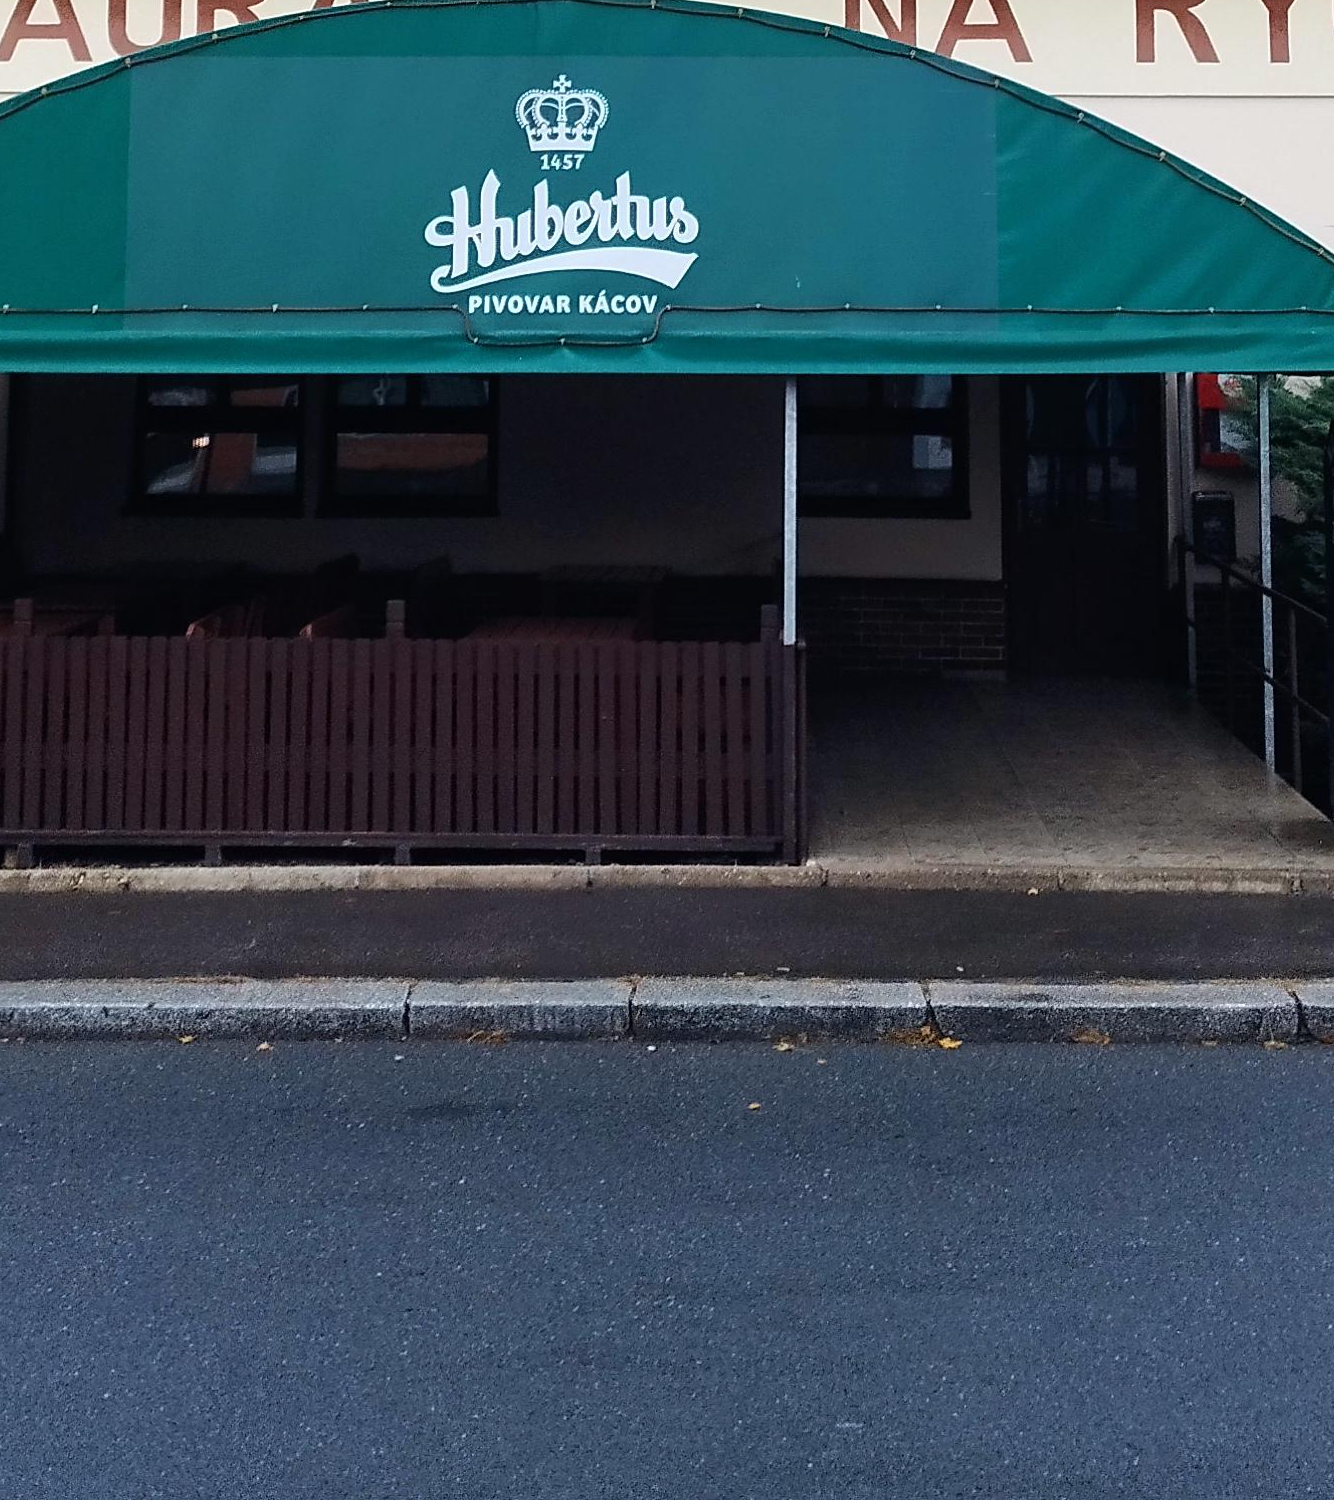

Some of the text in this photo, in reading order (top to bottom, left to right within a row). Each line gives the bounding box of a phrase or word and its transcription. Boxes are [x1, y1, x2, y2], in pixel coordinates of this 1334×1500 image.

[539, 153, 586, 172] 1457
[423, 167, 701, 281] Hubertus
[467, 289, 659, 315] PIVOVAR KÁCOV
